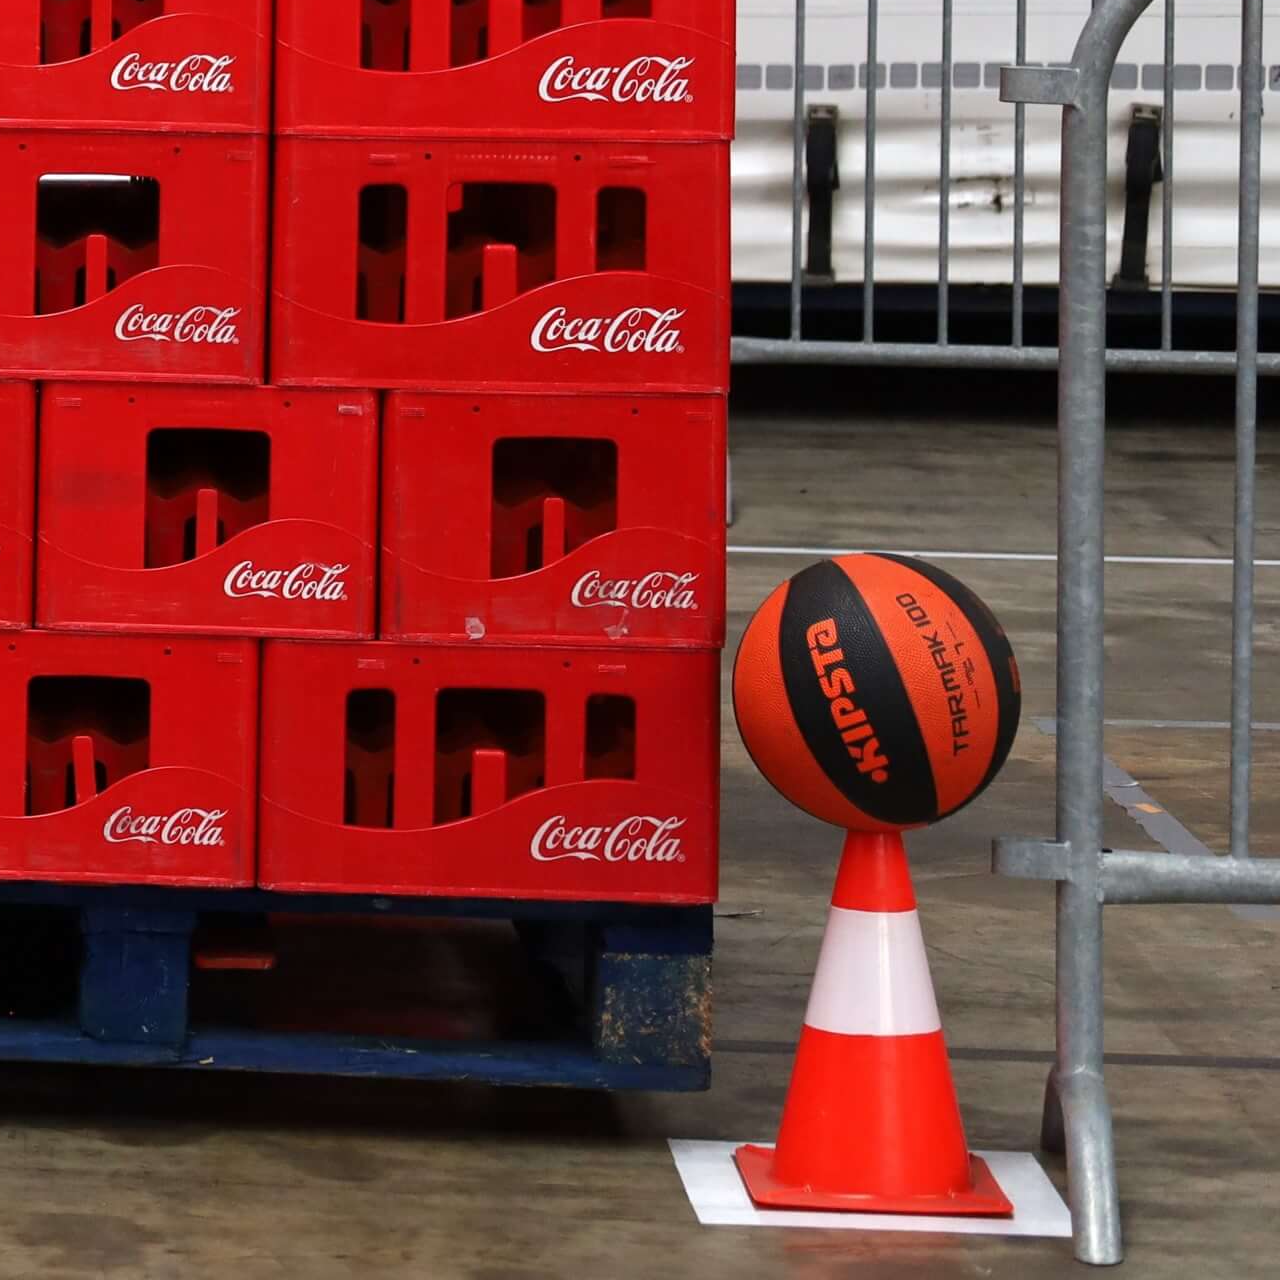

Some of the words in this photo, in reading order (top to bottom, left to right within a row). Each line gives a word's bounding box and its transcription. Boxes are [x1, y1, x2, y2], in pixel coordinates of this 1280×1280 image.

[111, 53, 236, 92] Coca-Cola
[539, 56, 695, 103] Coca-Cola
[115, 304, 241, 344] Coca-Cola
[531, 307, 686, 353] Coca-Cola
[224, 561, 349, 600] Coca-Cola
[571, 570, 699, 609] Coca-Cola
[894, 592, 931, 629] 100
[921, 632, 971, 757] TARMAK
[104, 806, 227, 846] Coca-Cola
[531, 816, 686, 862] Coca-Cola
